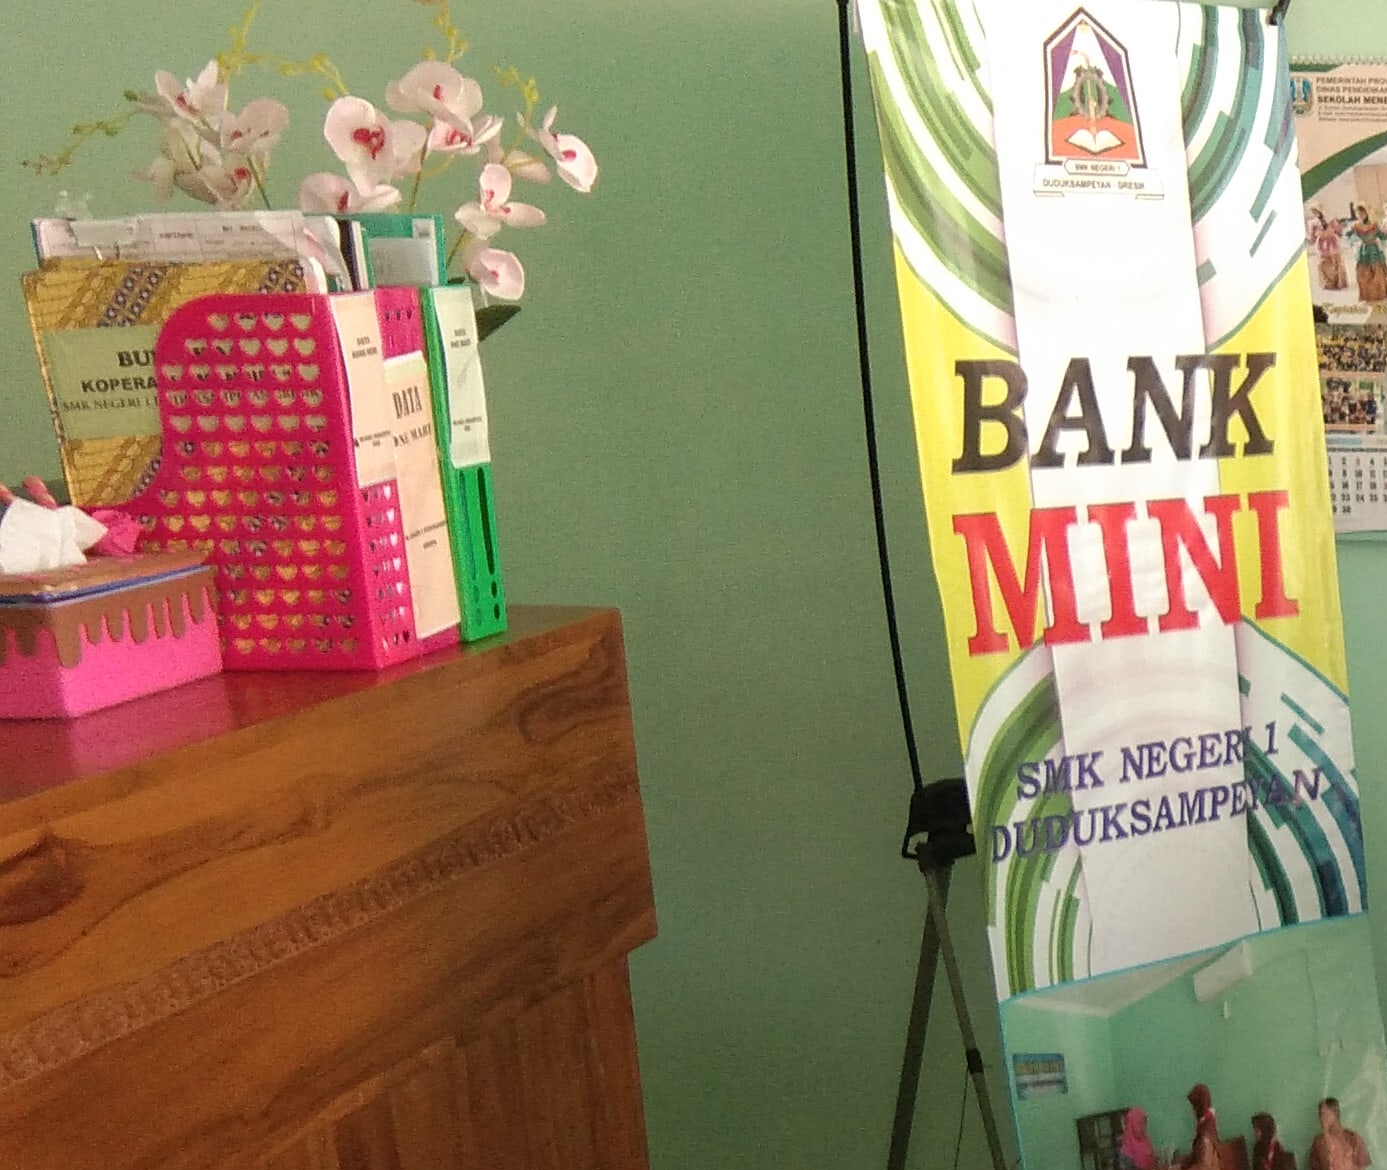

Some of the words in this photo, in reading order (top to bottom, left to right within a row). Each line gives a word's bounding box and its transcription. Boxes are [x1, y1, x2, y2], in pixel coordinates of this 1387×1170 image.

[1317, 95, 1361, 105] SEKOLAH
[81, 376, 158, 393] KOPERA
[392, 386, 423, 419] DATA
[951, 352, 1277, 475] BANK
[952, 490, 1301, 657] MINI
[1017, 750, 1104, 800] SMK
[1121, 726, 1253, 784] NEGERI
[1263, 721, 1280, 755] 1
[991, 767, 1325, 864] DUDUKSAMPEYAN
